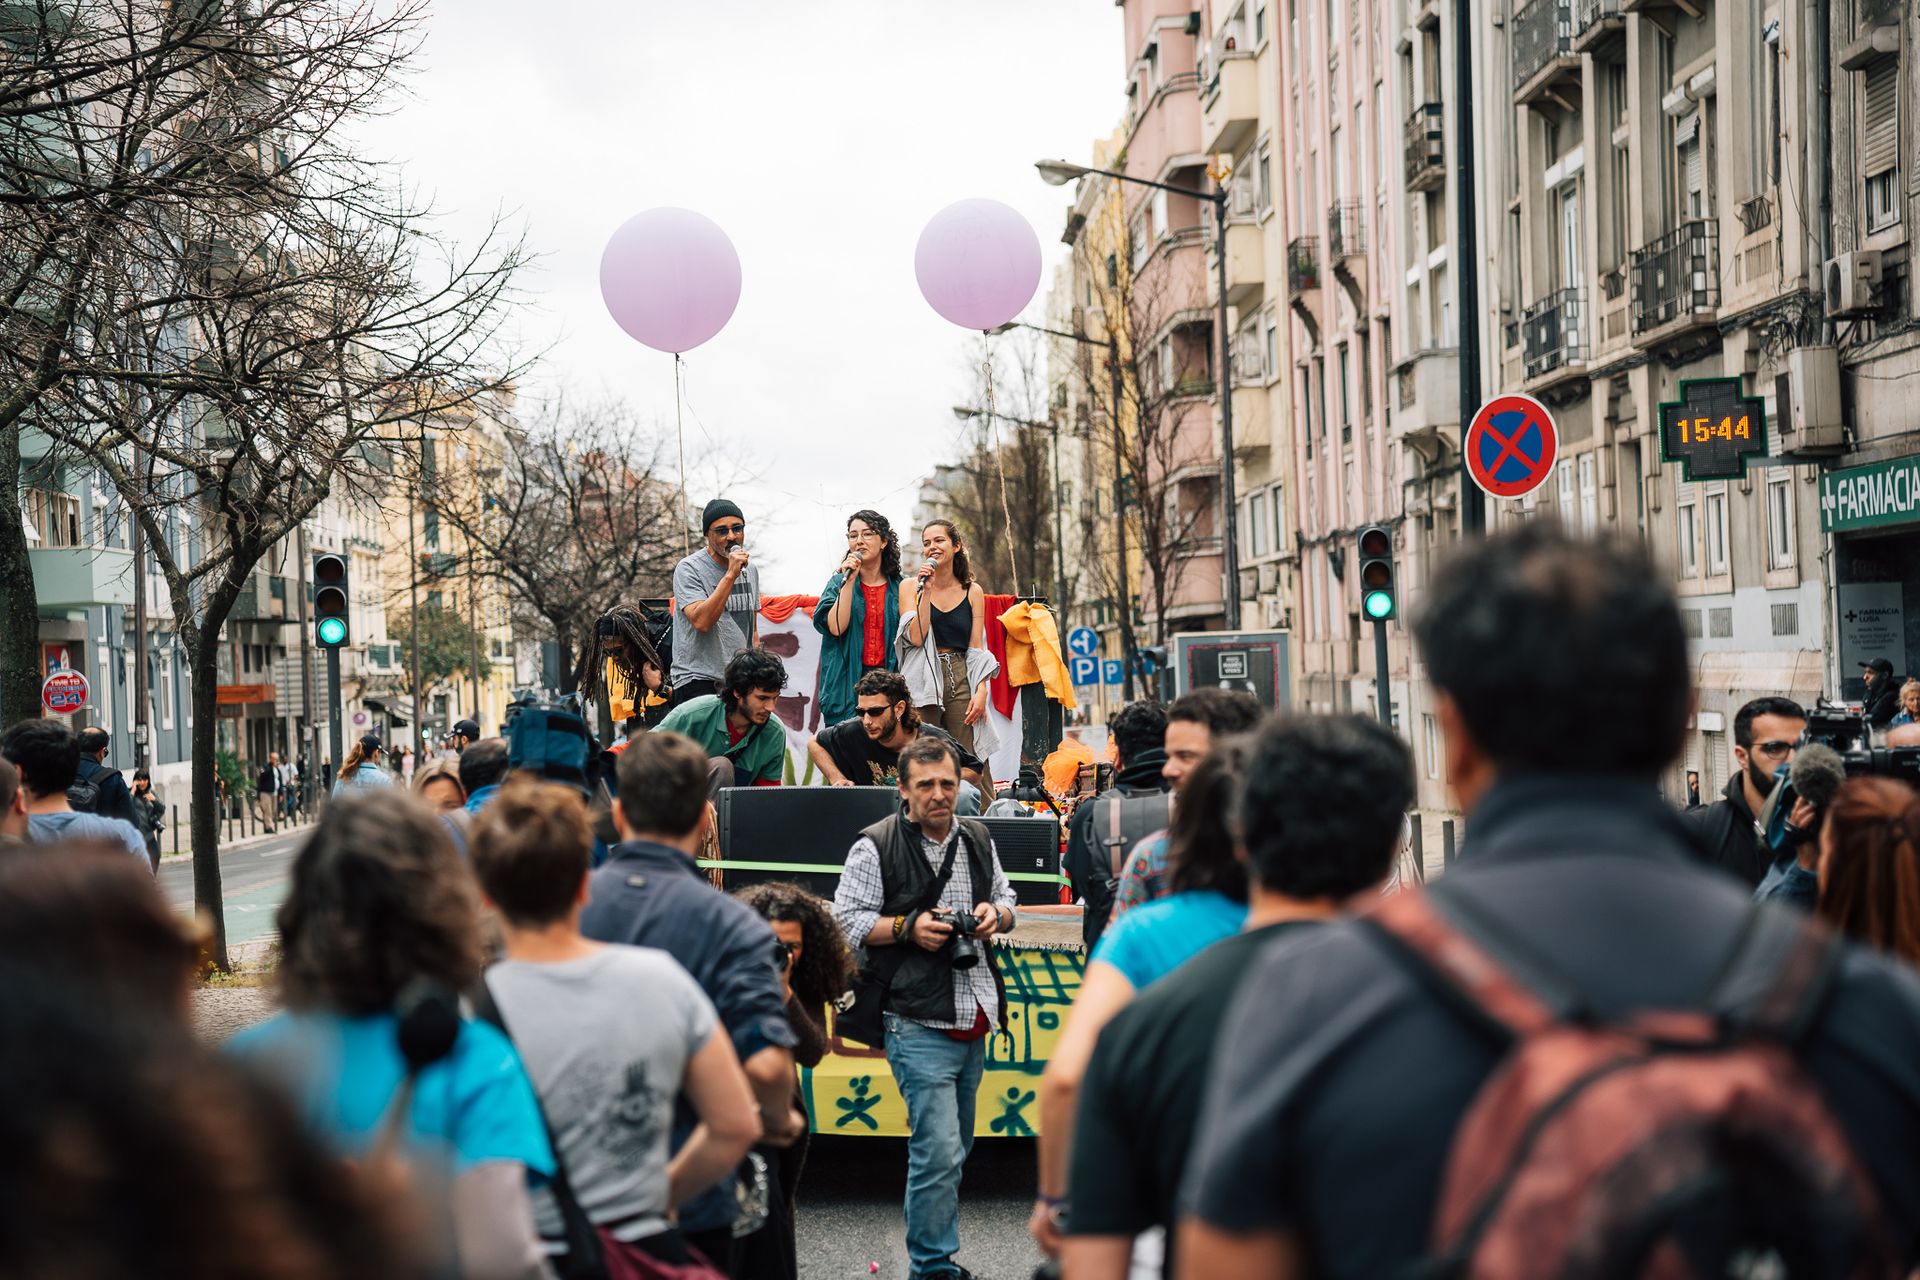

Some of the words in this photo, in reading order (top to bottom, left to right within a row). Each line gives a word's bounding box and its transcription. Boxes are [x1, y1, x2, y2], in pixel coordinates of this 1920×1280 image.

[1677, 415, 1749, 443] 15:44
[1838, 466, 1920, 520] FARMÁCIA
[1076, 659, 1094, 684] P
[1106, 663, 1117, 681] P
[50, 692, 82, 707] 24
